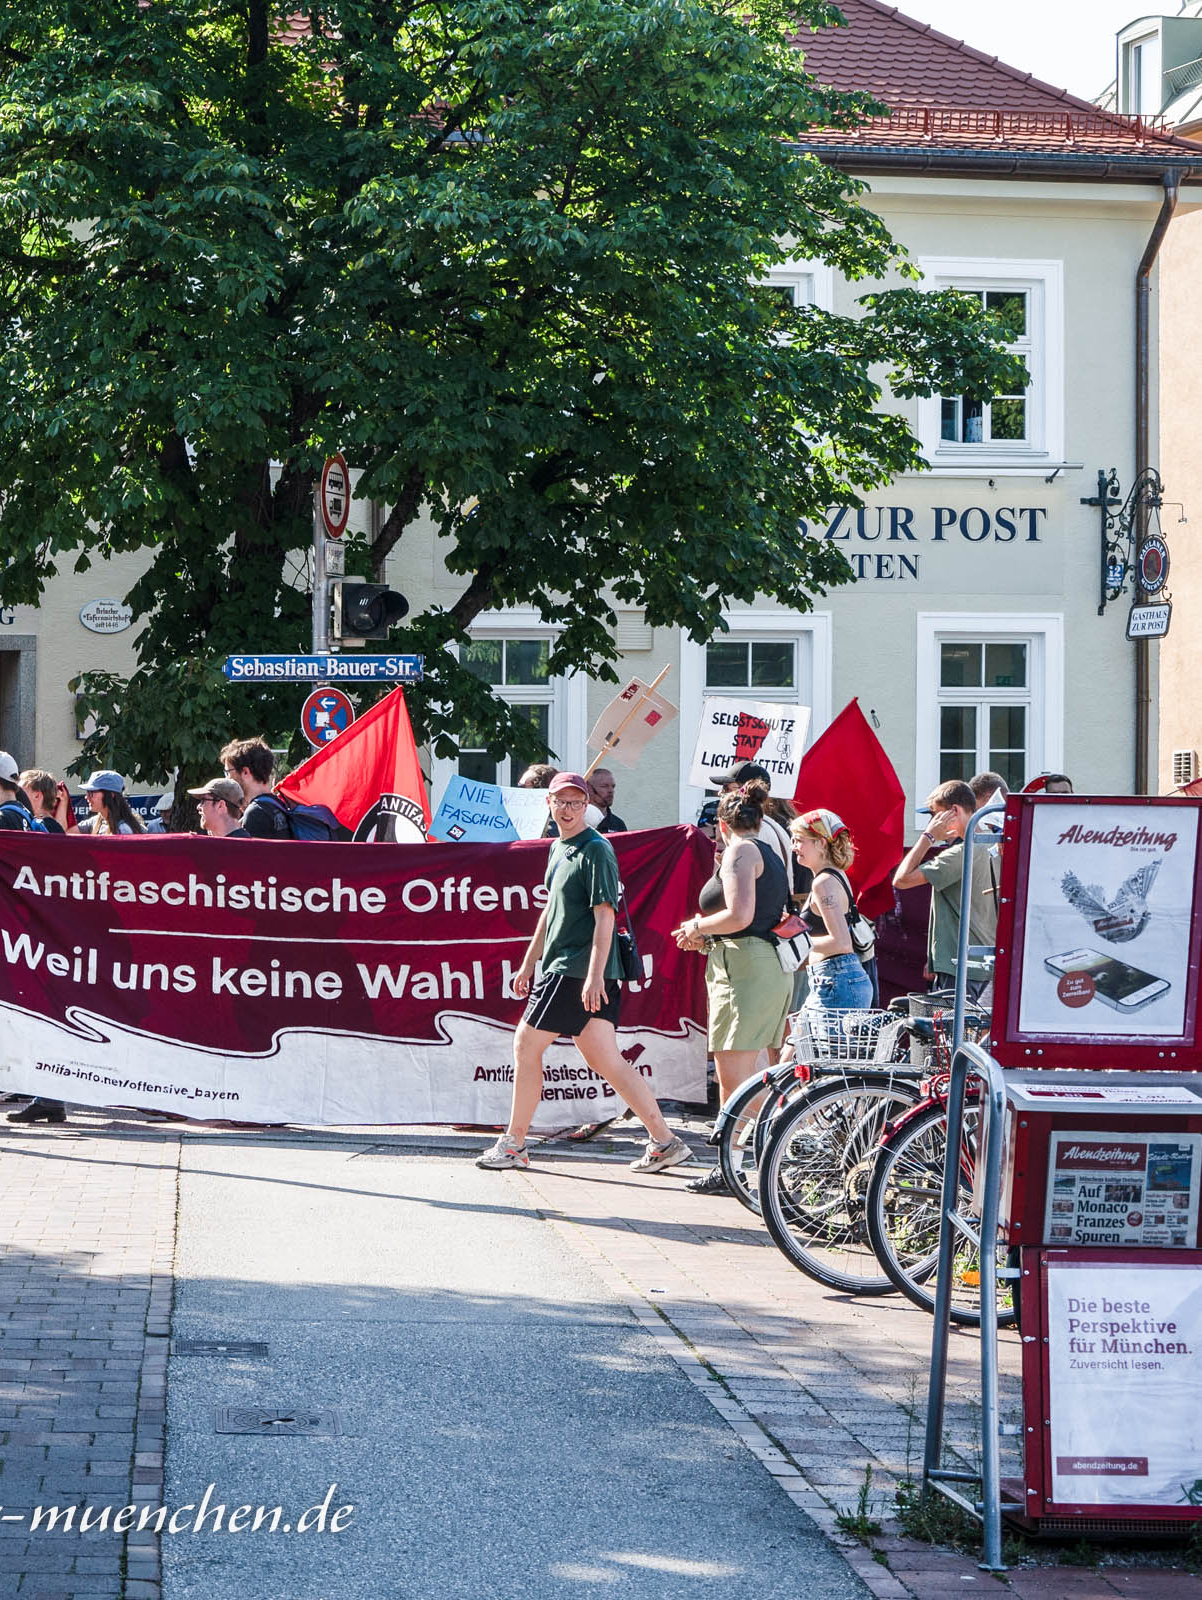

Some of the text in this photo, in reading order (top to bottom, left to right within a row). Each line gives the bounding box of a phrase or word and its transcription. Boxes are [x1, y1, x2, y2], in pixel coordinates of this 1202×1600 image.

[823, 506, 918, 541] ZUR
[931, 506, 1048, 542] POST
[1139, 540, 1166, 560] PAULANER
[851, 554, 920, 580] TEN
[1132, 610, 1167, 621] GASTHAUS
[1132, 621, 1165, 632] ZUR POST
[231, 658, 415, 677] Sebastian-Bauer-Str.
[712, 712, 795, 732] SELBSTSCHUTZ
[732, 734, 766, 748] STATT
[459, 783, 494, 804] NIE
[1056, 825, 1178, 852] Abendzeitung
[13, 866, 624, 913] Antifaschistische Offens
[1, 928, 97, 985] Weil
[113, 962, 197, 993] uns
[212, 957, 343, 999] keine
[356, 961, 485, 1000] Wahl
[1062, 1146, 1140, 1165] Abendzeitung
[1078, 1185, 1102, 1198] Auf
[1078, 1201, 1128, 1213] Monaco
[1076, 1215, 1125, 1228] Franzes
[1075, 1230, 1120, 1244] Spuren
[1068, 1297, 1150, 1313] Die beste
[1068, 1318, 1177, 1336] Perspektive
[1069, 1338, 1193, 1354] für München.
[1070, 1359, 1165, 1370] Zuversicht lesen.
[1072, 1461, 1138, 1471] abendzeitung.de
